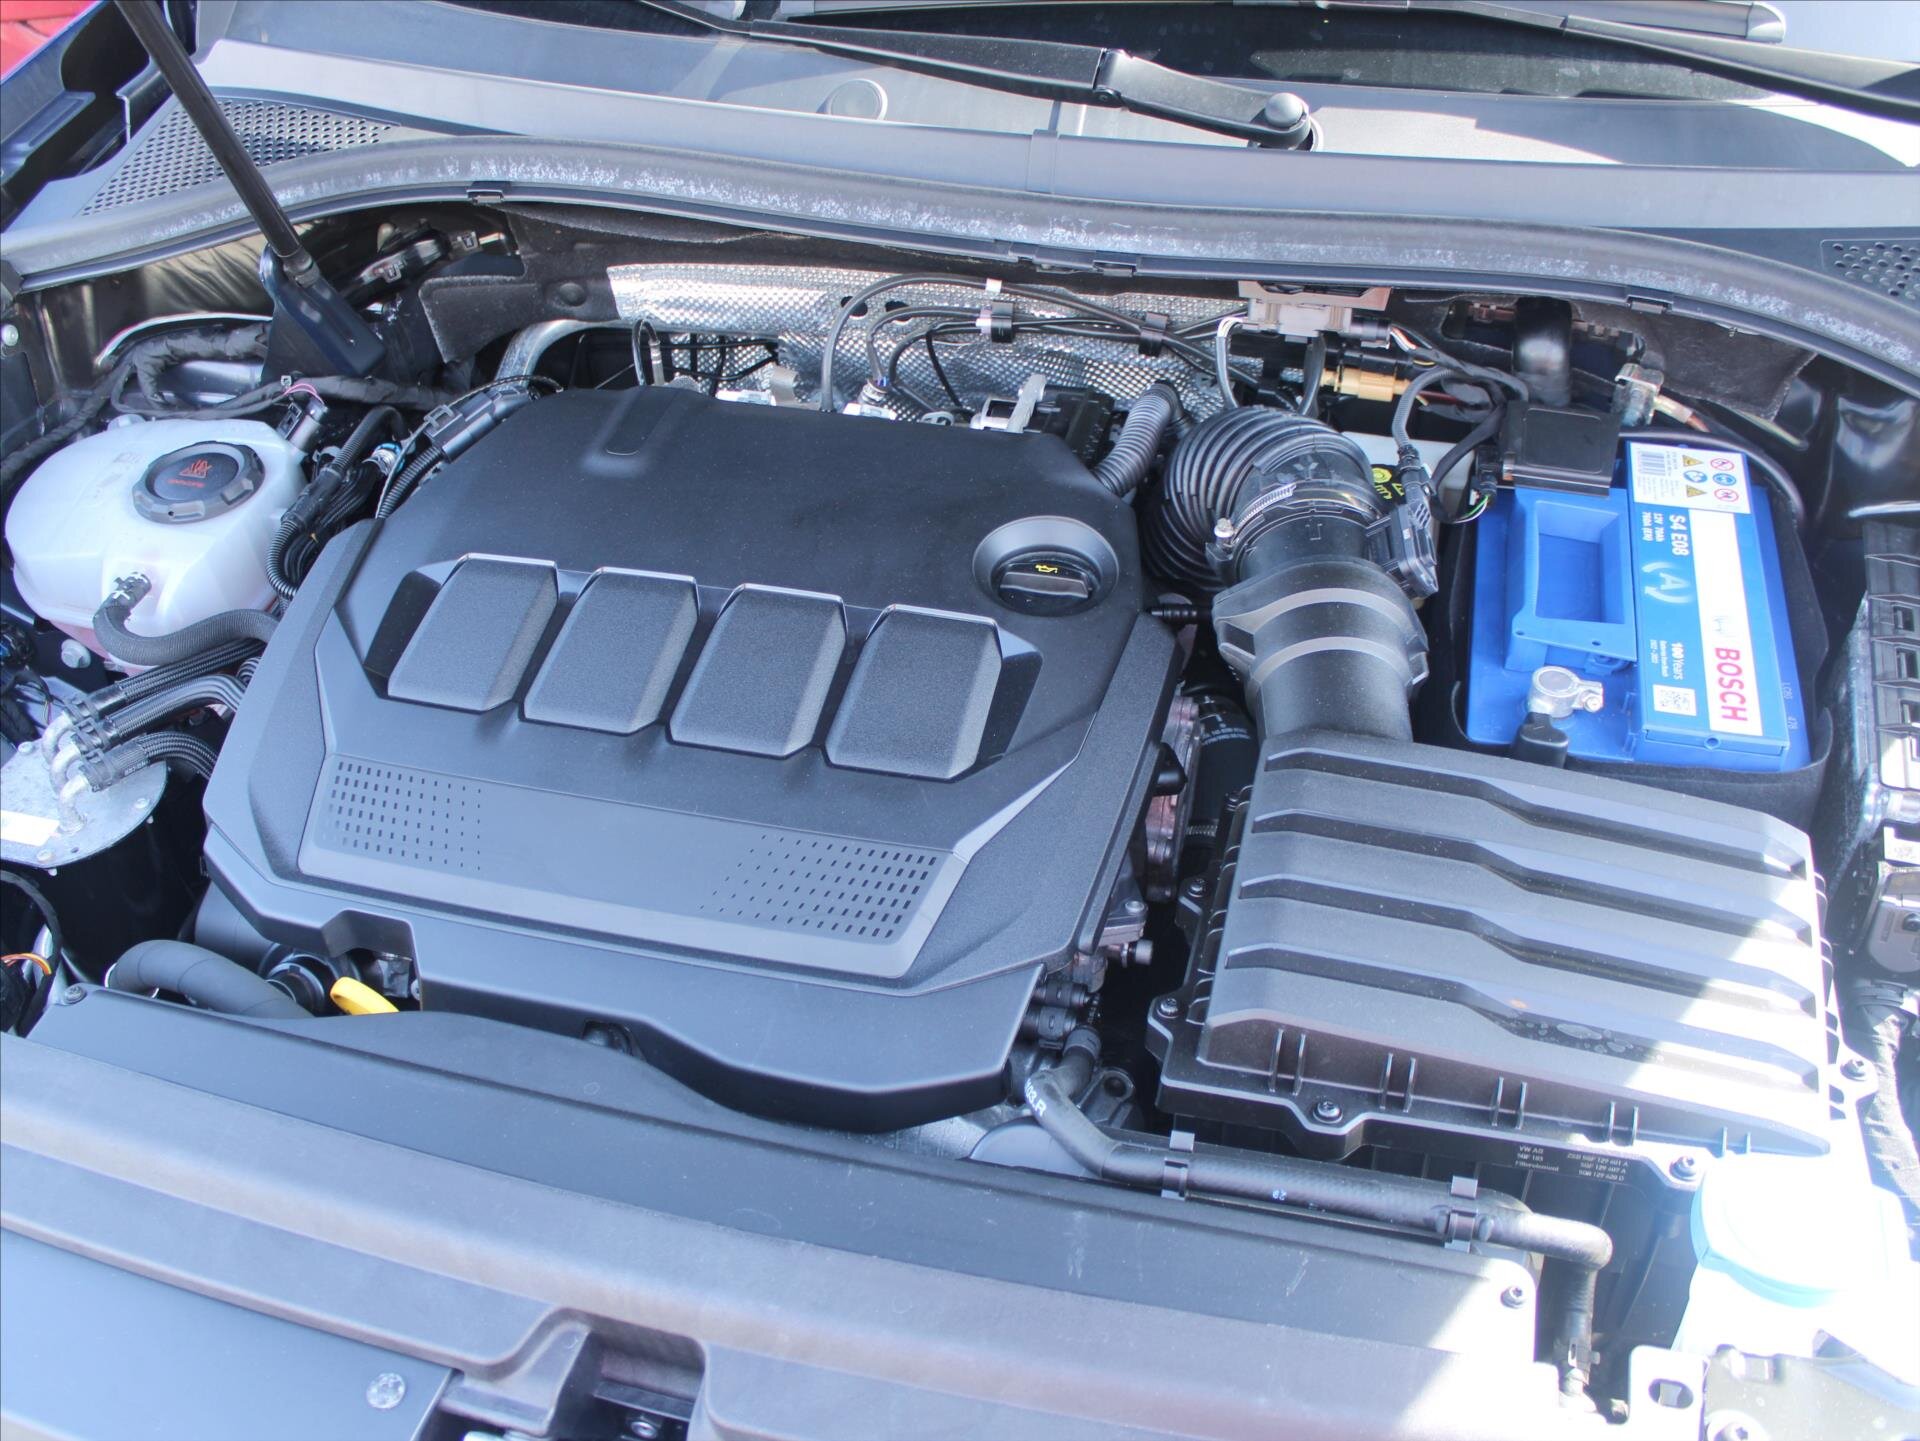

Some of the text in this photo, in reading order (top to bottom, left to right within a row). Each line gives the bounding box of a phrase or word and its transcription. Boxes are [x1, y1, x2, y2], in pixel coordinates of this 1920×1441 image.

[1669, 514, 1689, 556] S4 E08
[1714, 647, 1748, 721] BOSCH
